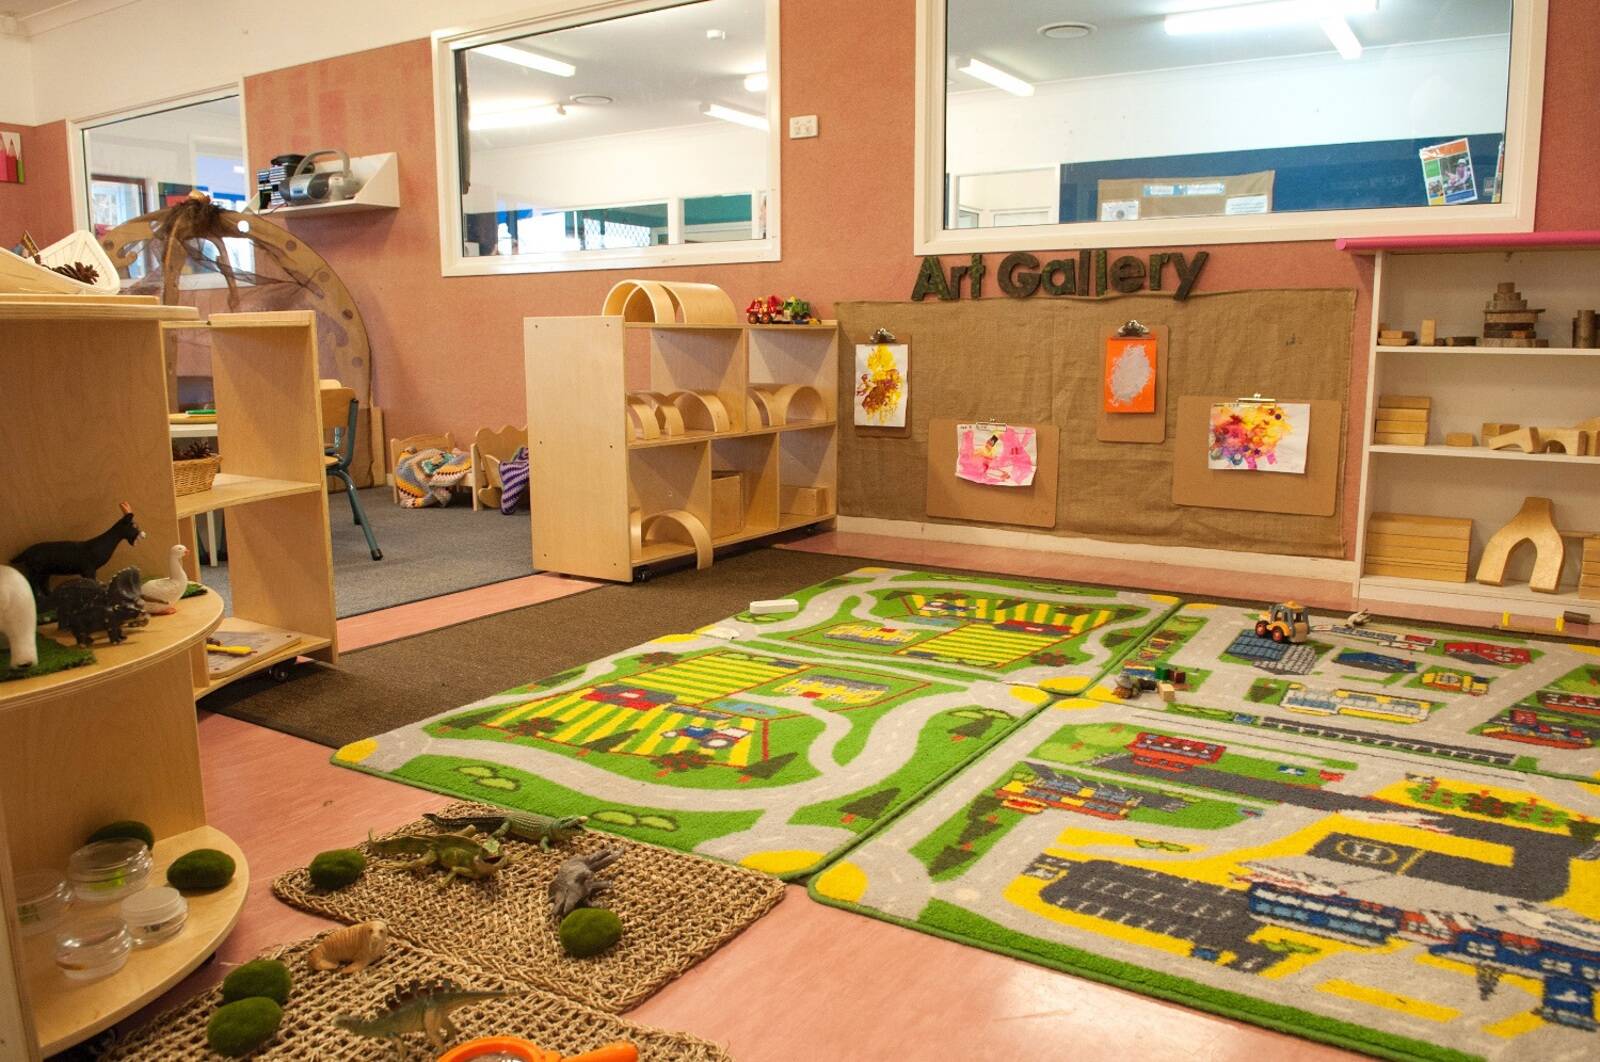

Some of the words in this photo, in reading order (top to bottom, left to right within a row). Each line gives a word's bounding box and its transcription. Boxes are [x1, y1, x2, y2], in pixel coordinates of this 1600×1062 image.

[911, 253, 986, 302] Art
[997, 249, 1209, 301] Gallery
[1353, 843, 1382, 861] H
